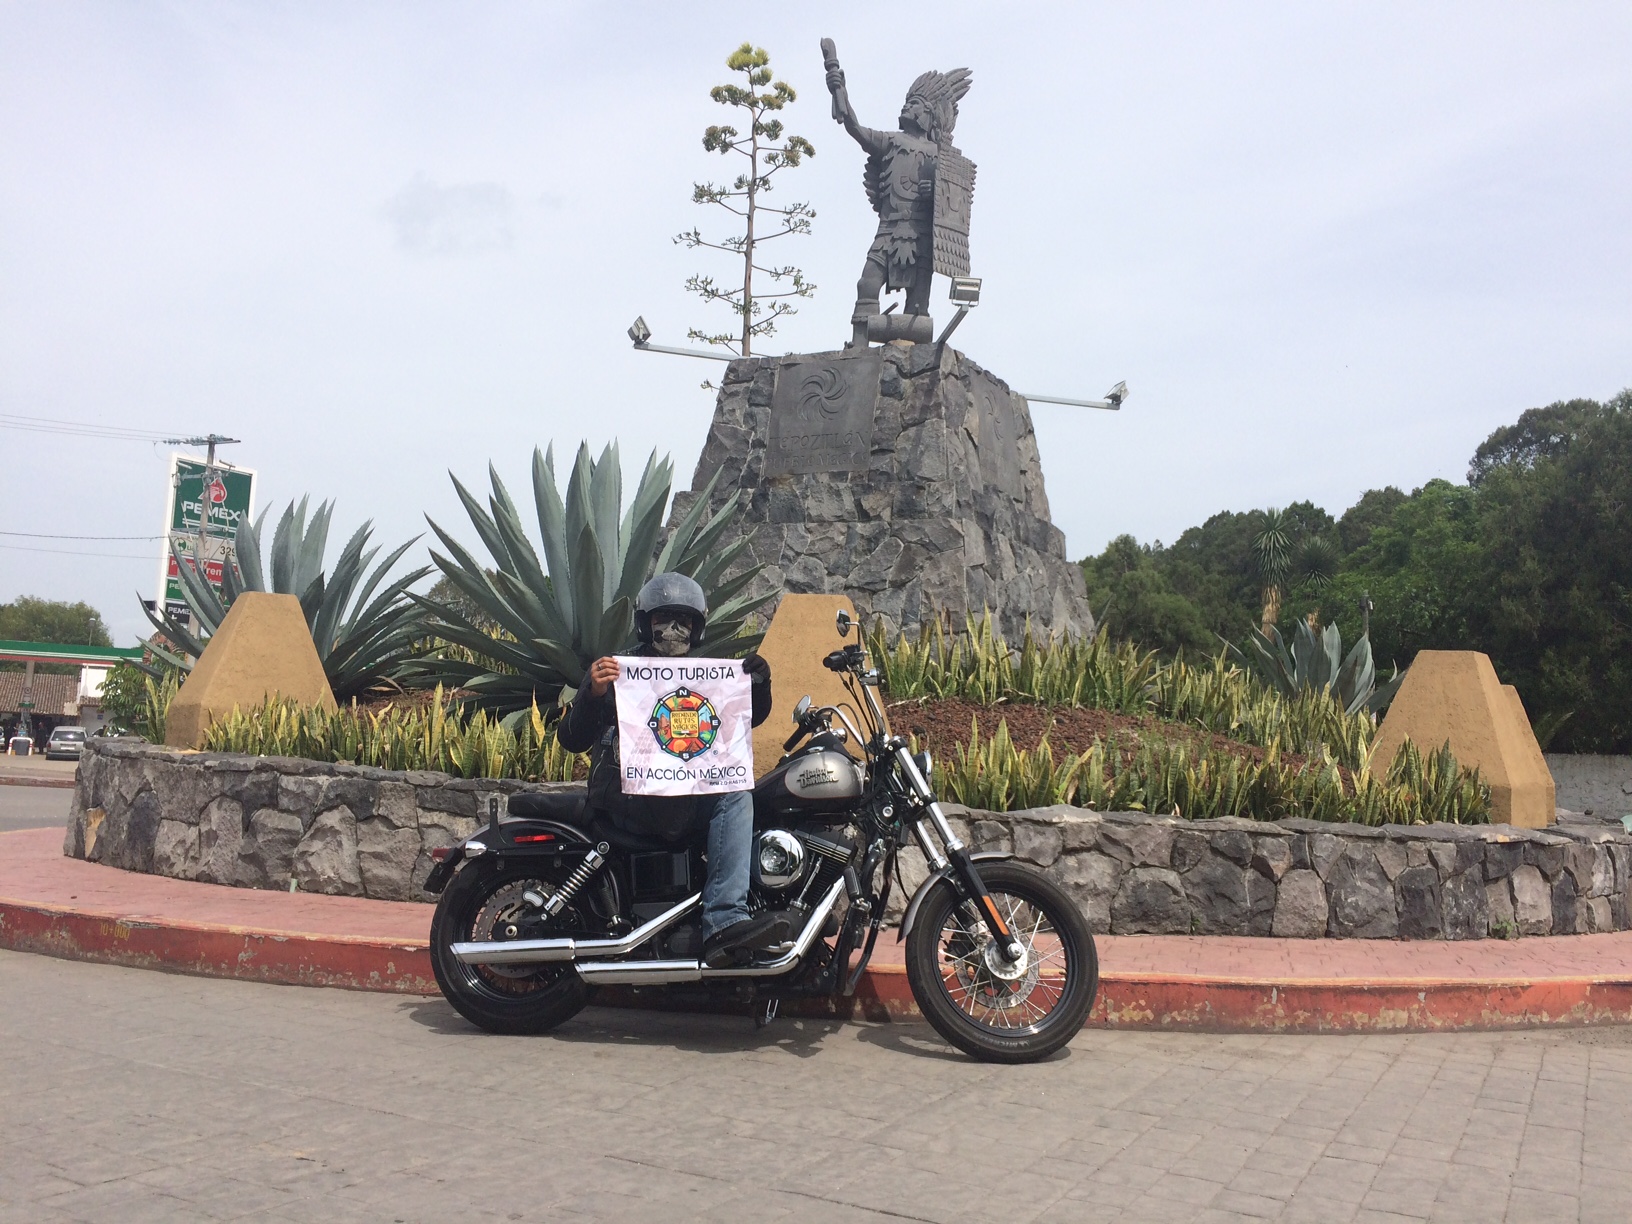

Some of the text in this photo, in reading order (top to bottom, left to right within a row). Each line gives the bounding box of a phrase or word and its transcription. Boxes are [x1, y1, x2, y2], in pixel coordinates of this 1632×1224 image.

[182, 500, 241, 521] PEMEX
[167, 606, 190, 614] PEME
[626, 666, 735, 680] MOTO TURISTA
[682, 752, 689, 760] S
[626, 765, 747, 781] EN ACCIÓN MÉXICO
